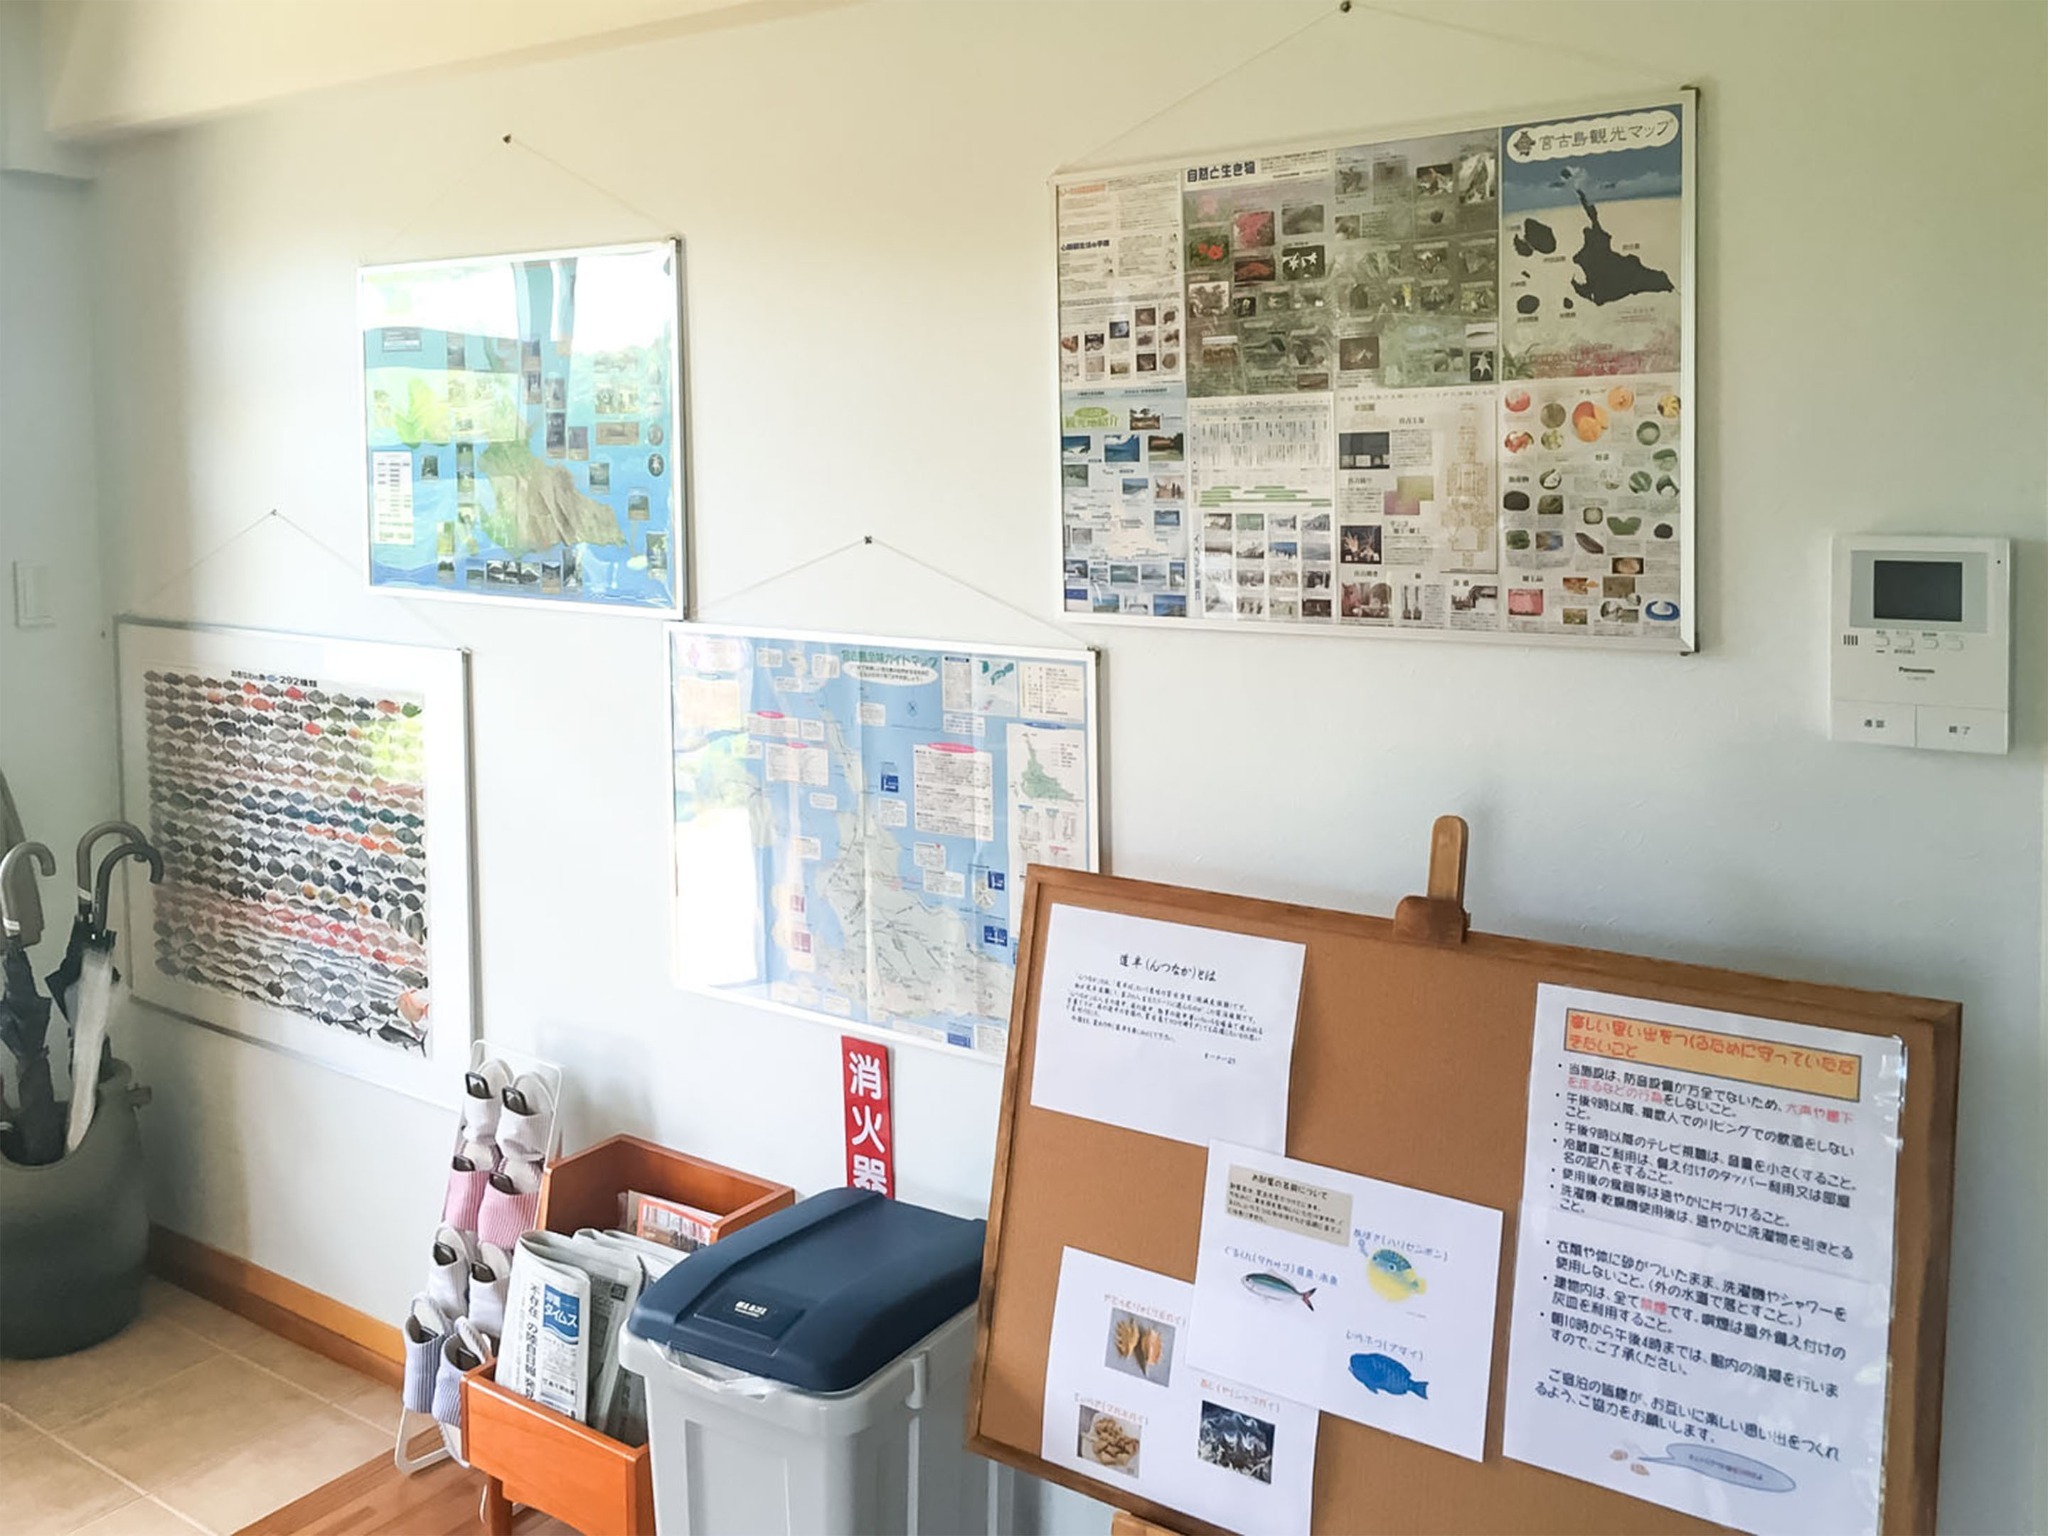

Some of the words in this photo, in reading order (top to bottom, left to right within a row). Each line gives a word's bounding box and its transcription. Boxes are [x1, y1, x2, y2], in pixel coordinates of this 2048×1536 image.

[1538, 118, 1674, 152] 宮古島観光マップ
[1187, 160, 1256, 183] 自然と生き物
[848, 1050, 888, 1194] 消火器
[544, 1303, 579, 1328] タイムス
